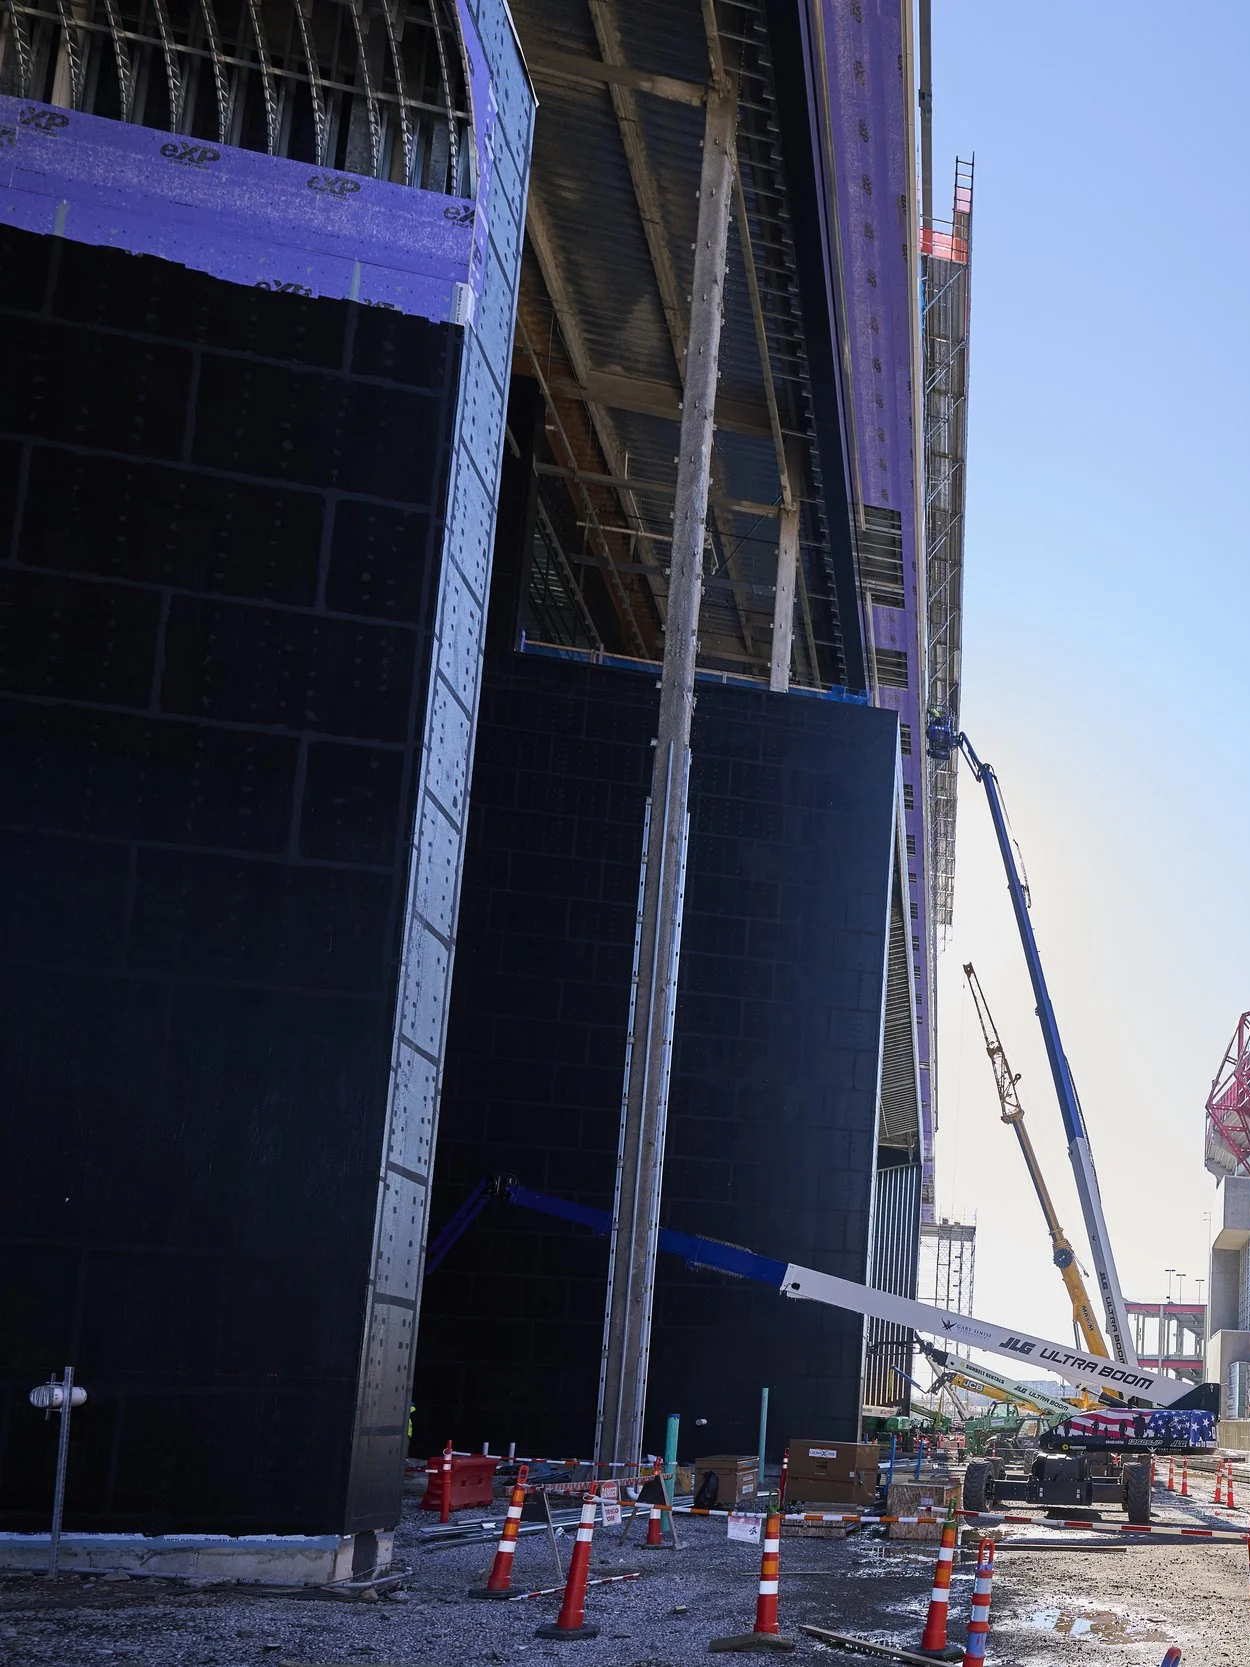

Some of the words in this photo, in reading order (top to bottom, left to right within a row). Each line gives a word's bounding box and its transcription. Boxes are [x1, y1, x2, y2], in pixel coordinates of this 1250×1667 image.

[160, 141, 221, 165] eXP
[306, 172, 361, 195] eXP
[443, 204, 475, 226] eX
[1099, 1271, 1109, 1290] JLG
[1105, 1296, 1118, 1332] ULTRA
[956, 1324, 972, 1332] GARY
[973, 1328, 992, 1338] SINISE
[966, 1364, 986, 1377] SUNBELT
[986, 1372, 1005, 1384] RENTALS
[999, 1336, 1036, 1355] JLG
[1039, 1347, 1099, 1373] ULTRA
[1098, 1365, 1154, 1390] BOOM
[963, 1380, 984, 1392] JCB
[1014, 1385, 1027, 1394] JLG
[1028, 1391, 1050, 1404] ULTRA
[1049, 1400, 1069, 1411] BOOM
